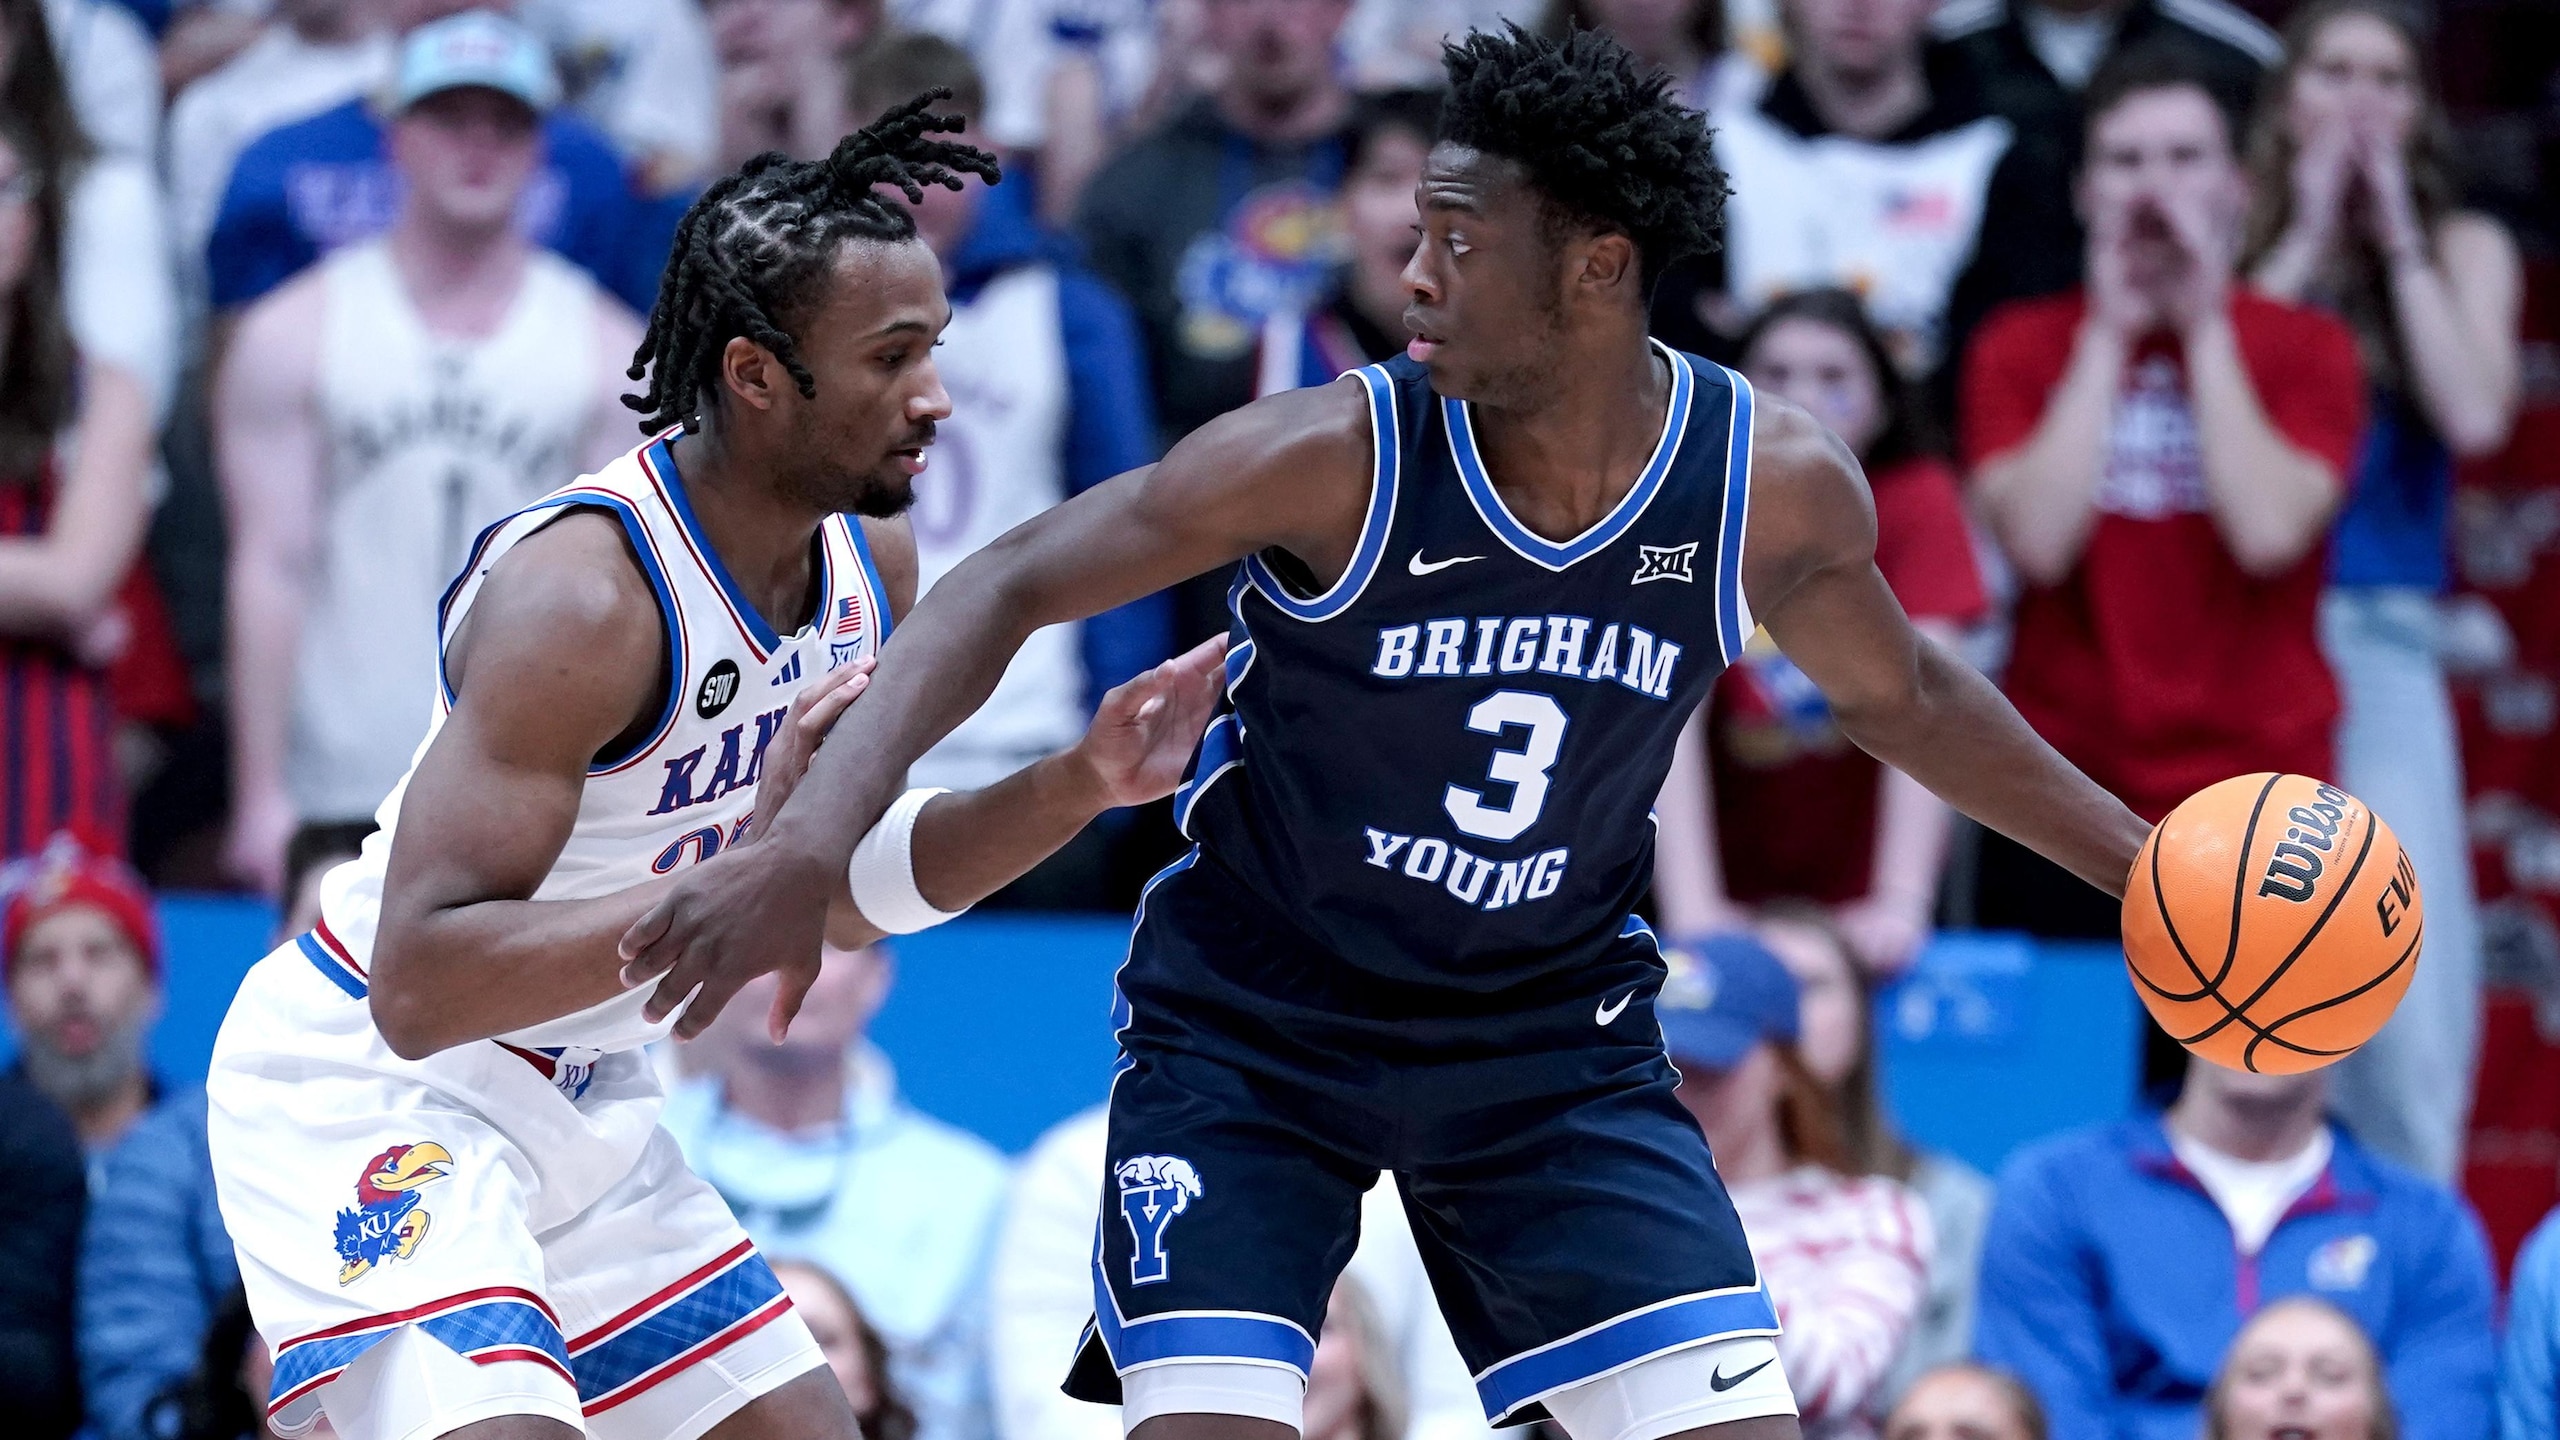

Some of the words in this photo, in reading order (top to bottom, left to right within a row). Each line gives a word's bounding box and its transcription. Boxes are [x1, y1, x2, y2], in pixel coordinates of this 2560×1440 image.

[701, 671, 736, 708] SW
[1370, 614, 1684, 700] BRIGHAM
[1442, 688, 1570, 843] 3
[1363, 826, 1570, 911] YOUNG
[358, 1210, 391, 1243] KU
[1120, 1184, 1177, 1288] Y
